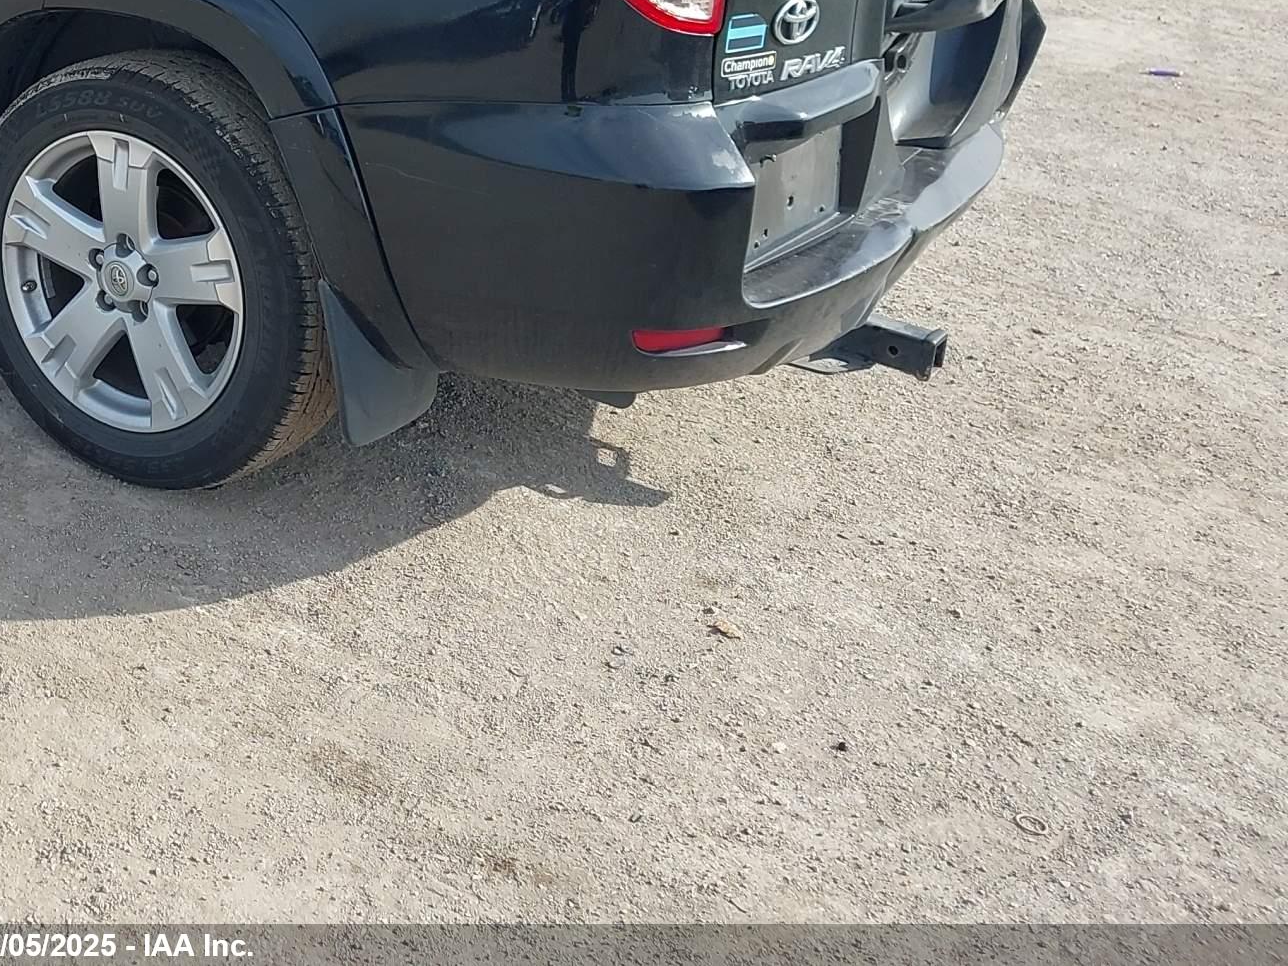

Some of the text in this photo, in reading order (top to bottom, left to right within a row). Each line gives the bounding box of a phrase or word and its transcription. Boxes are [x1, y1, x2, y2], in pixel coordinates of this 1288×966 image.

[724, 56, 769, 73] Champion
[780, 46, 845, 81] RAV4
[728, 71, 774, 89] TOYOTA
